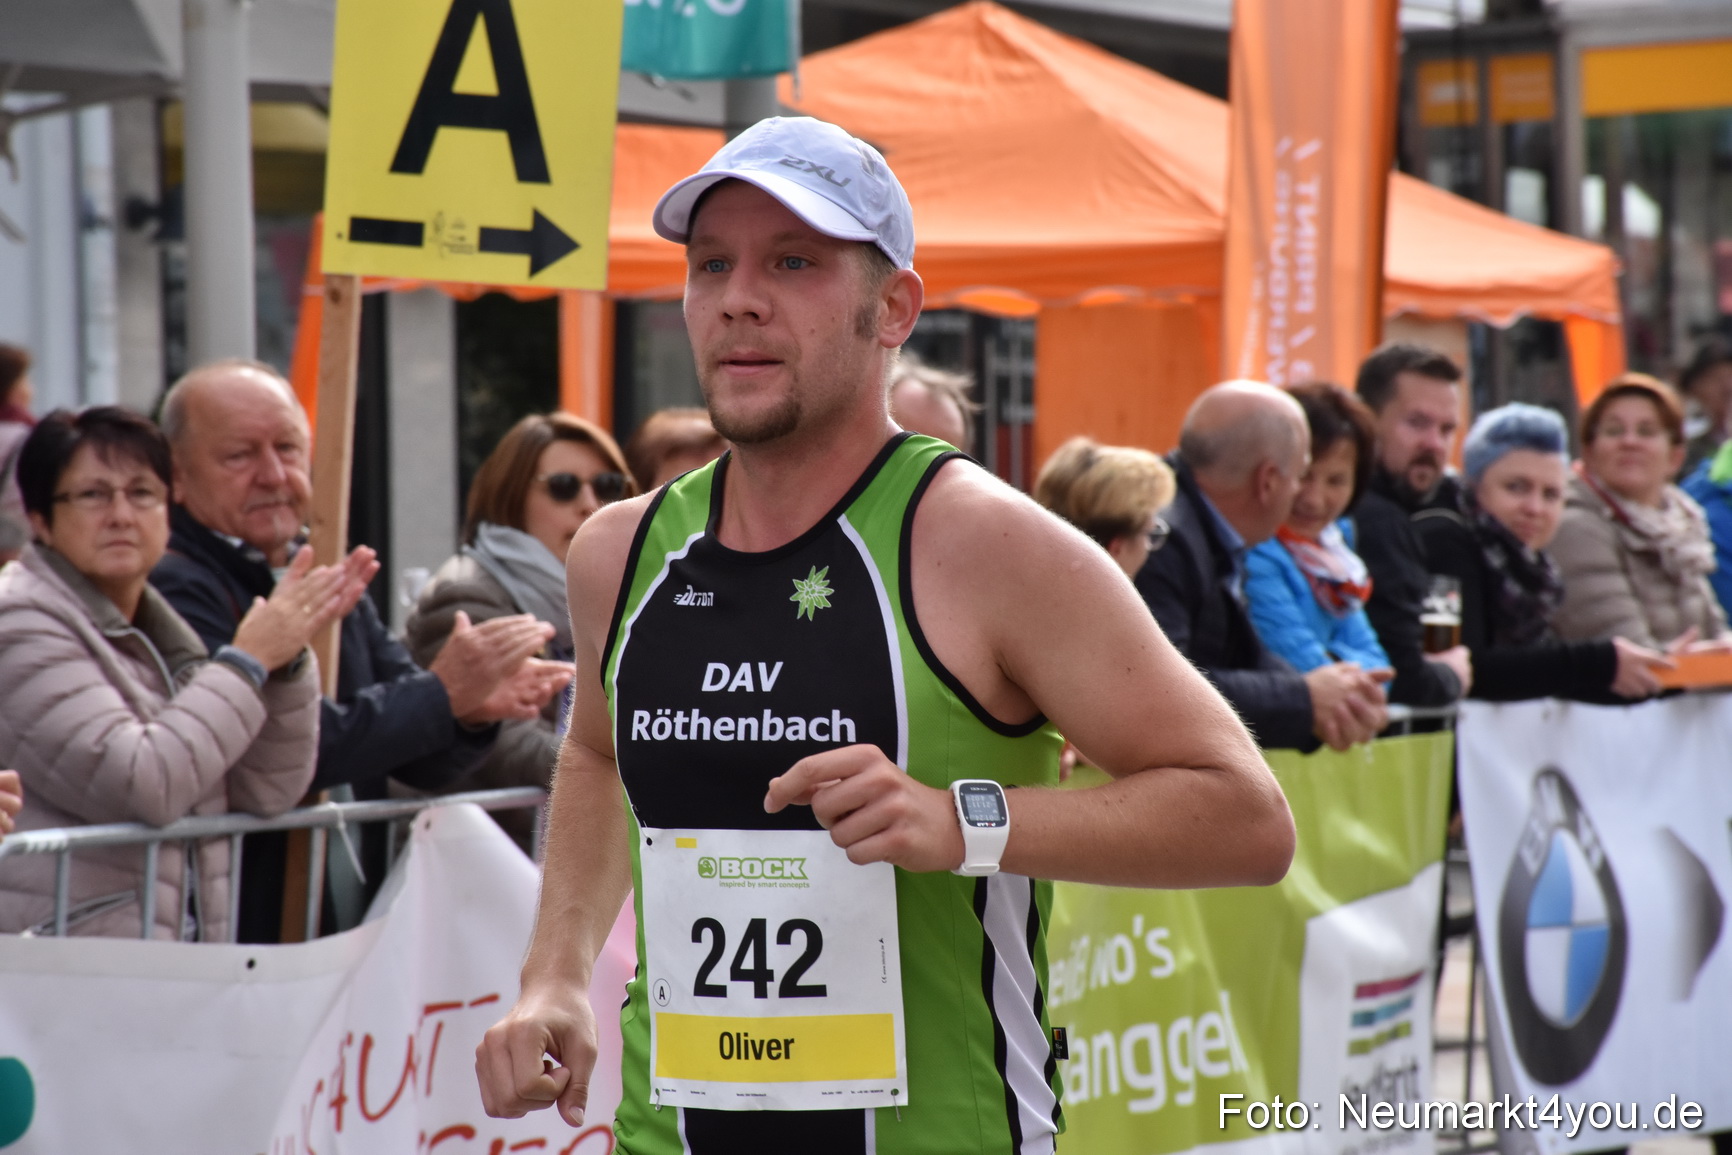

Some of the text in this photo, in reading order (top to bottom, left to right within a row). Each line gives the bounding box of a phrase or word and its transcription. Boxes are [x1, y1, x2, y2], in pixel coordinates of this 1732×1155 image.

[388, 0, 552, 186] A
[779, 154, 852, 188] 2XU
[701, 662, 783, 692] DAV
[631, 709, 856, 742] Röthenbach
[719, 857, 808, 880] BOCK
[719, 880, 746, 889] inspired
[747, 880, 756, 889] by
[778, 880, 811, 889] concepts
[691, 917, 827, 999] 242
[658, 985, 666, 1001] A
[719, 1031, 795, 1060] Oliver
